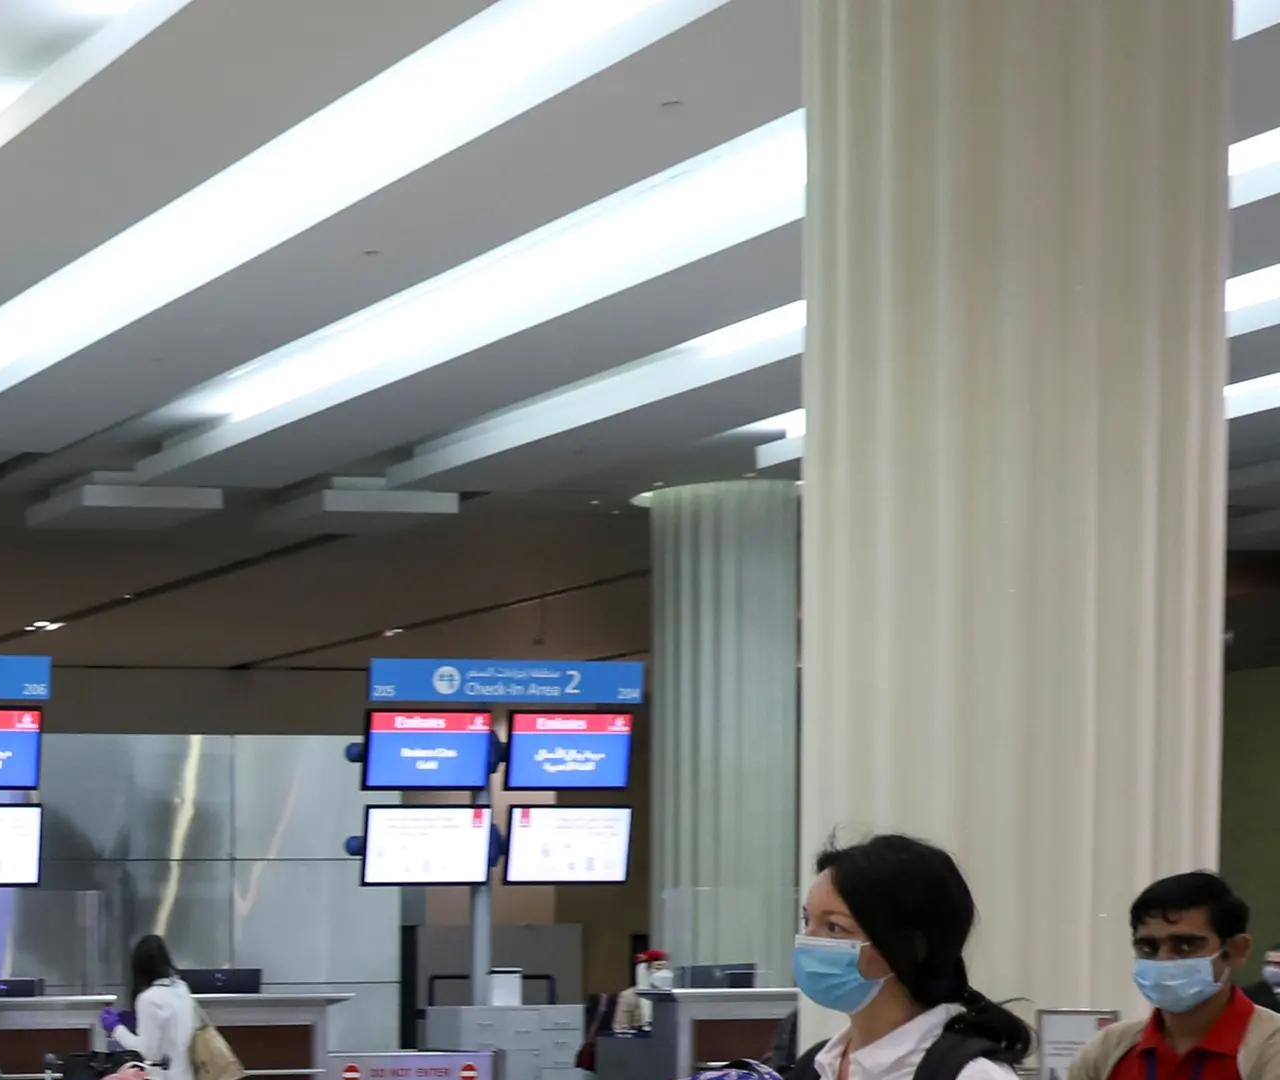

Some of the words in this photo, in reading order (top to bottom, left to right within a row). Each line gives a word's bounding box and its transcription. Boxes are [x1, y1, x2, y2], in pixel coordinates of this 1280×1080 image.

[564, 671, 582, 694] 2
[464, 682, 526, 697] Check-In
[527, 684, 561, 697] Area
[394, 716, 446, 729] Emirates
[536, 717, 587, 730] Emirates
[390, 1067, 412, 1077] NOT
[415, 1067, 450, 1077] ENTER
